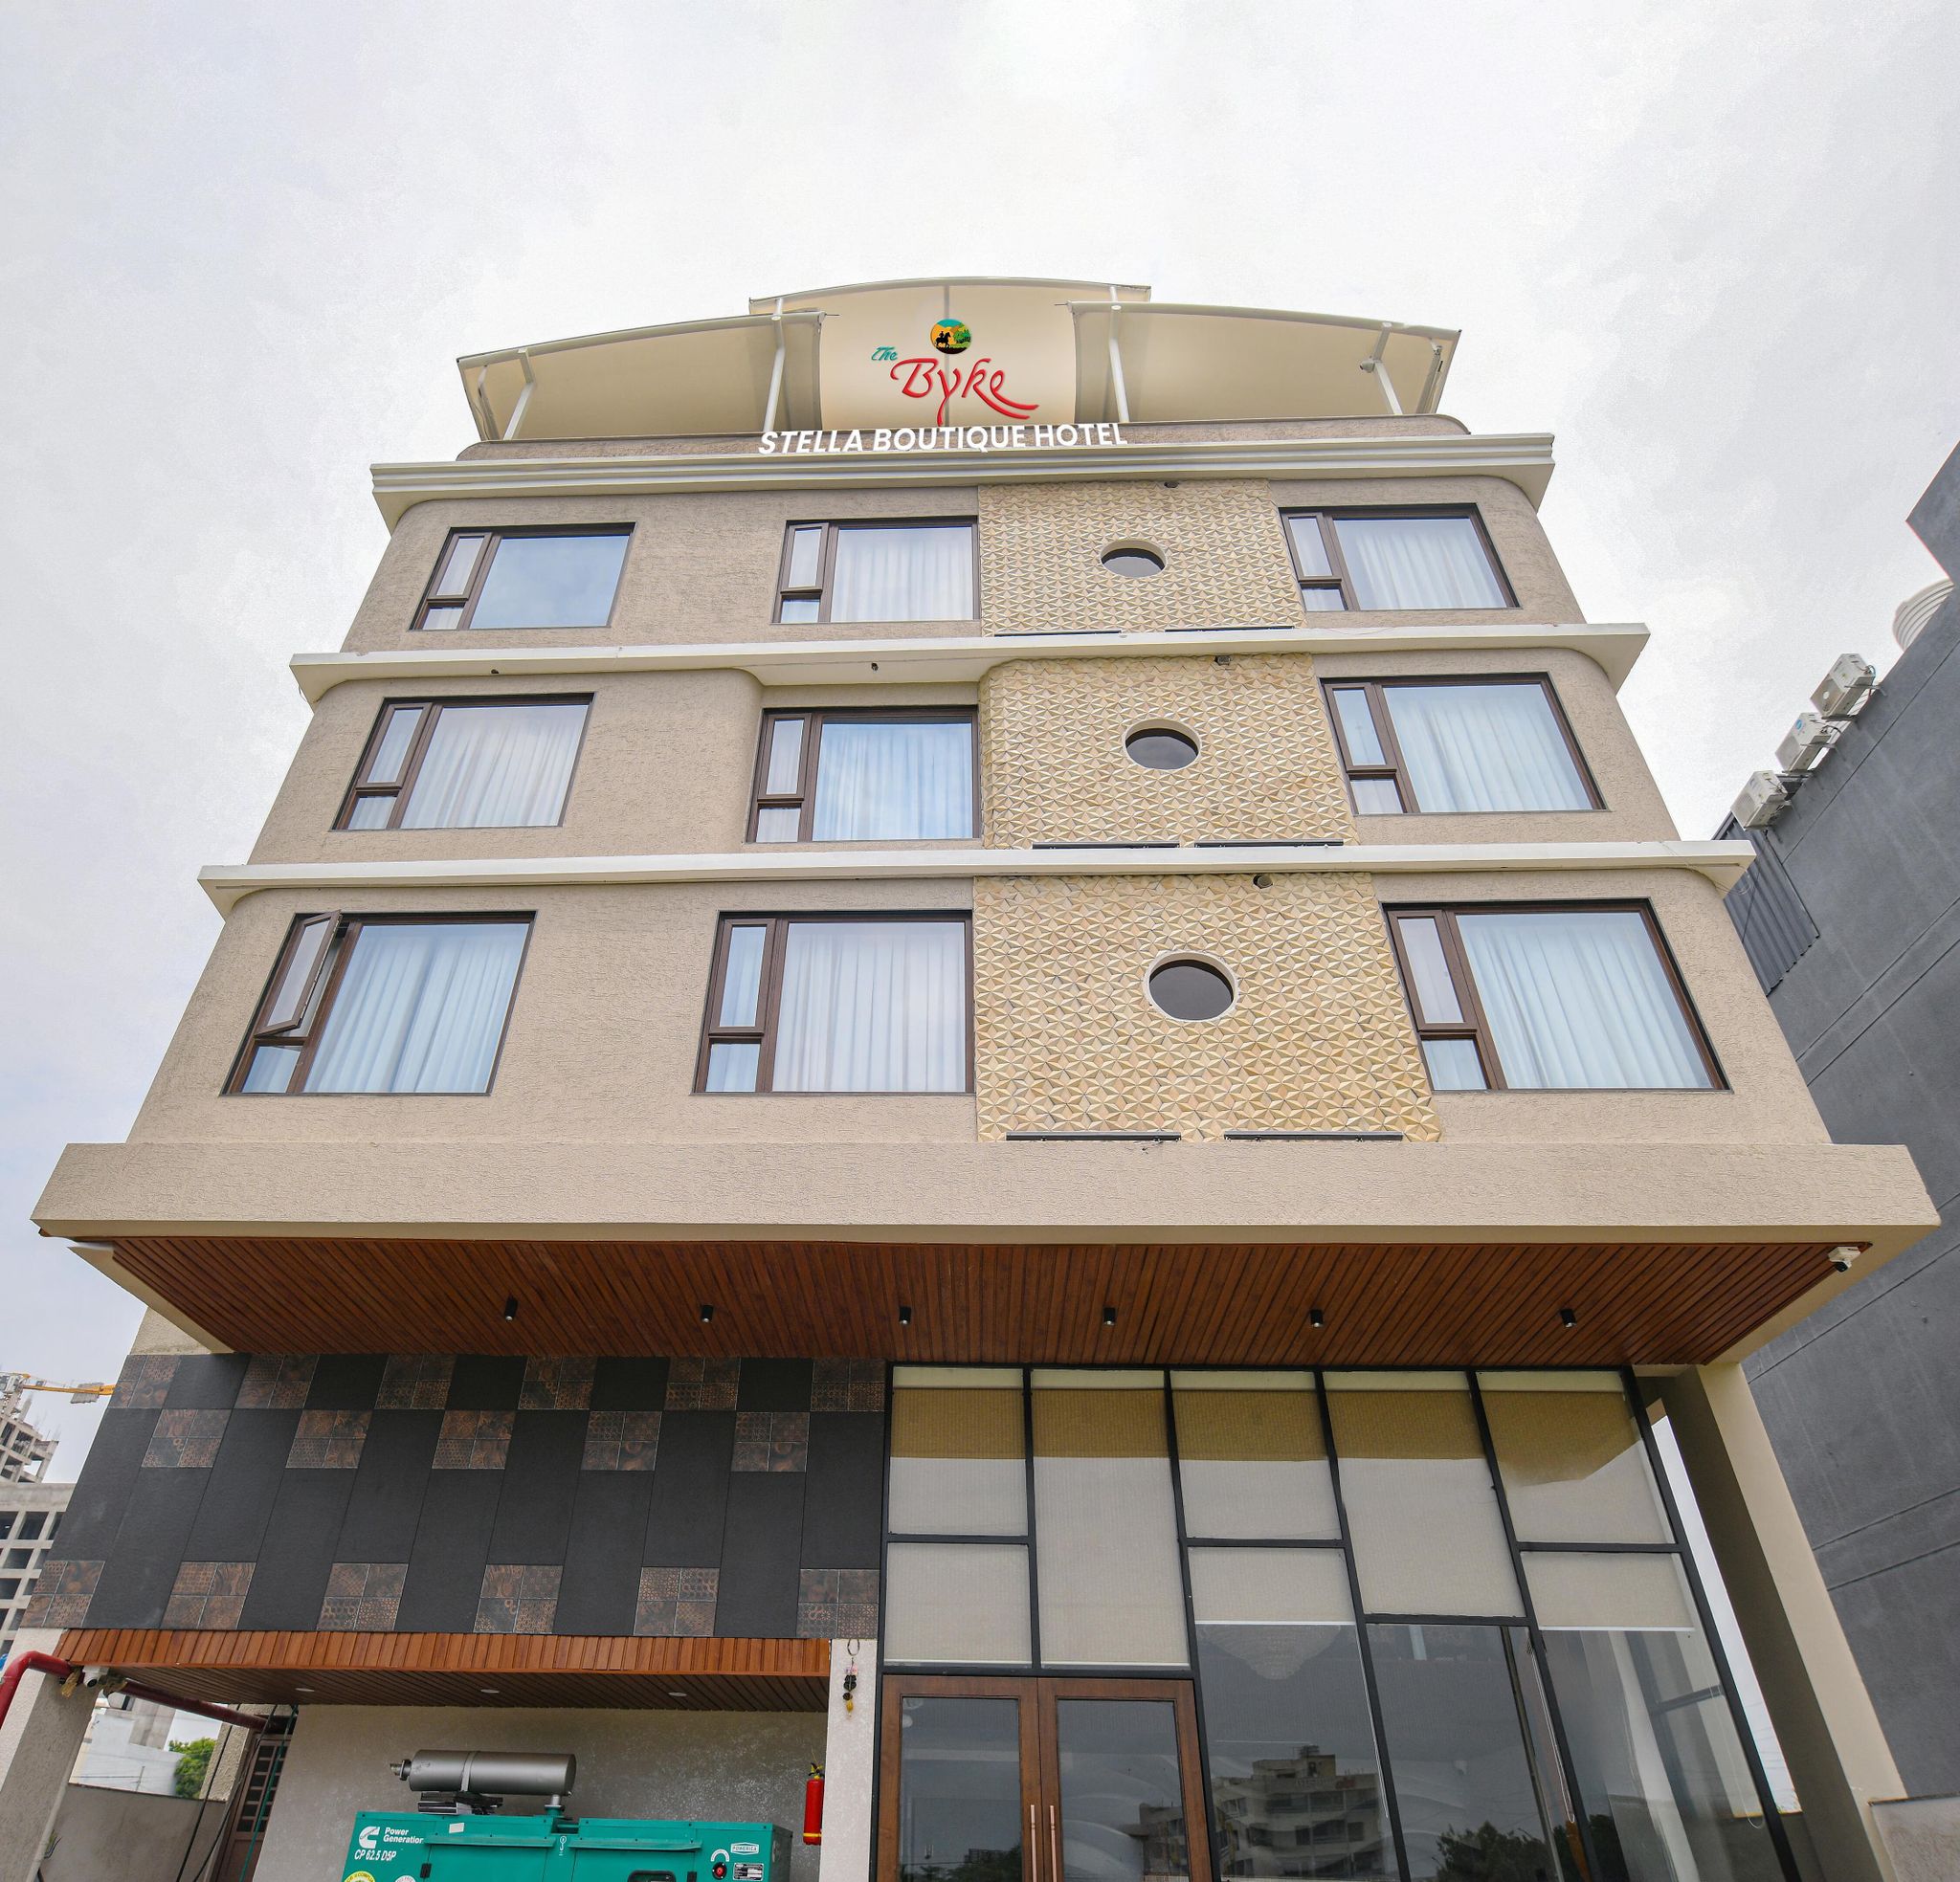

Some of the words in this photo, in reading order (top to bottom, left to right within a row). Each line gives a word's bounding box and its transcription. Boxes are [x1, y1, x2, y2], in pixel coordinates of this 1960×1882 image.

[871, 345, 899, 361] The
[889, 357, 1040, 428] Byke
[758, 430, 863, 454] STELLA
[872, 426, 1027, 453] BOUTIQUE
[1034, 423, 1128, 448] HOTEL
[354, 1849, 366, 1860] CP
[366, 1849, 381, 1861] 62.5
